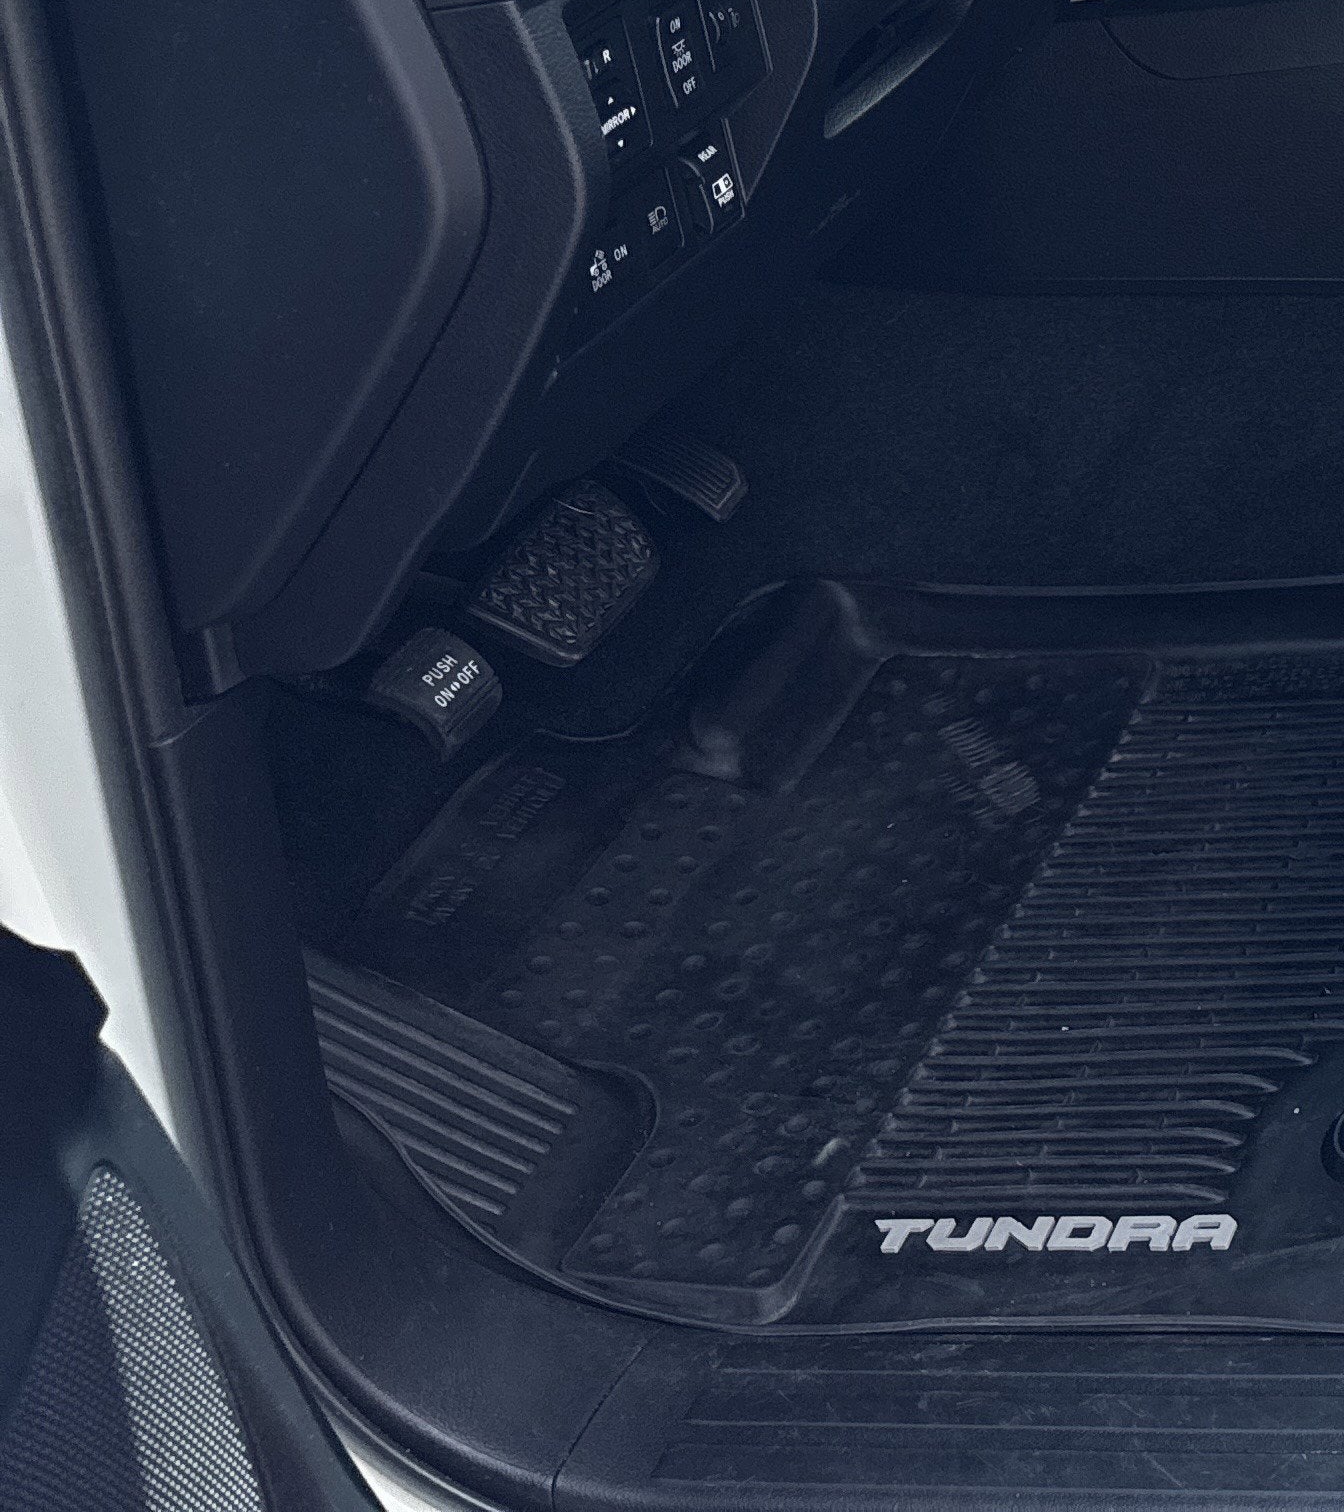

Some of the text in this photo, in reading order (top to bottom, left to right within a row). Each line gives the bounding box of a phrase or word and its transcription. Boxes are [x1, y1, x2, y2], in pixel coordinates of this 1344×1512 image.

[669, 16, 682, 34] ON
[602, 49, 612, 64] R
[671, 50, 693, 74] DOOR
[682, 76, 697, 95] OFF
[601, 108, 631, 136] MIRROR
[652, 216, 669, 235] AUTO
[613, 244, 629, 262] ON
[592, 269, 613, 293] DOOR
[421, 654, 459, 687] PUSH
[434, 659, 480, 708] ON OFF
[874, 1213, 1239, 1255] TUNDRA
